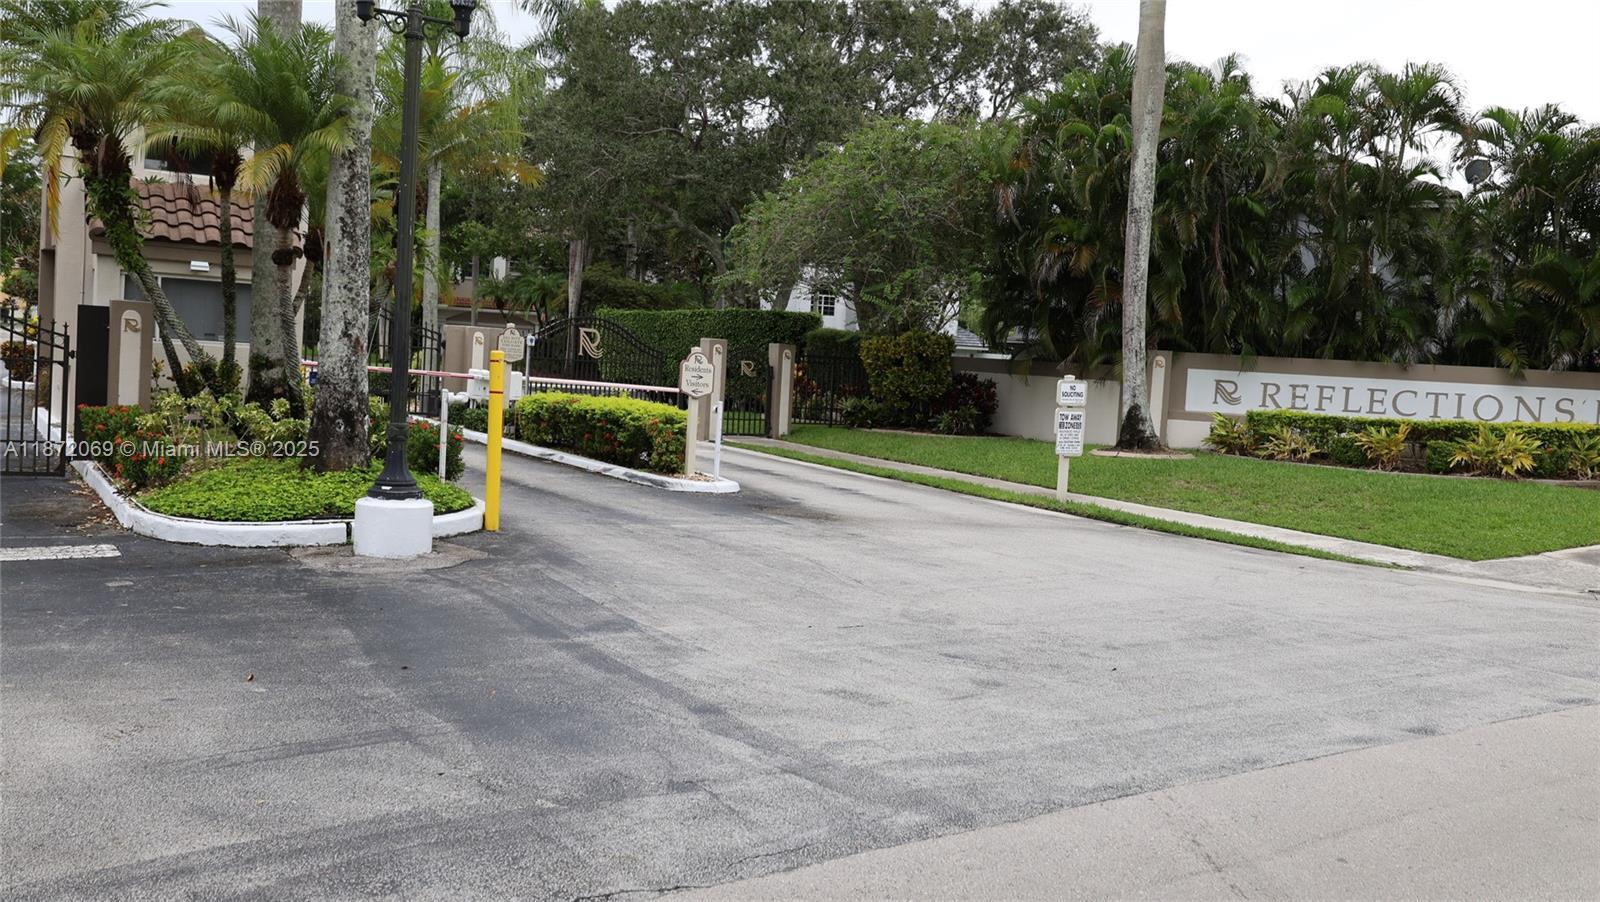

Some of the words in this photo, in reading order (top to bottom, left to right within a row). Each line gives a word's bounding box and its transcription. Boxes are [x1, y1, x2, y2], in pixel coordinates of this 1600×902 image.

[578, 327, 605, 359] R
[684, 364, 711, 373] Residents
[687, 379, 709, 388] Visitors
